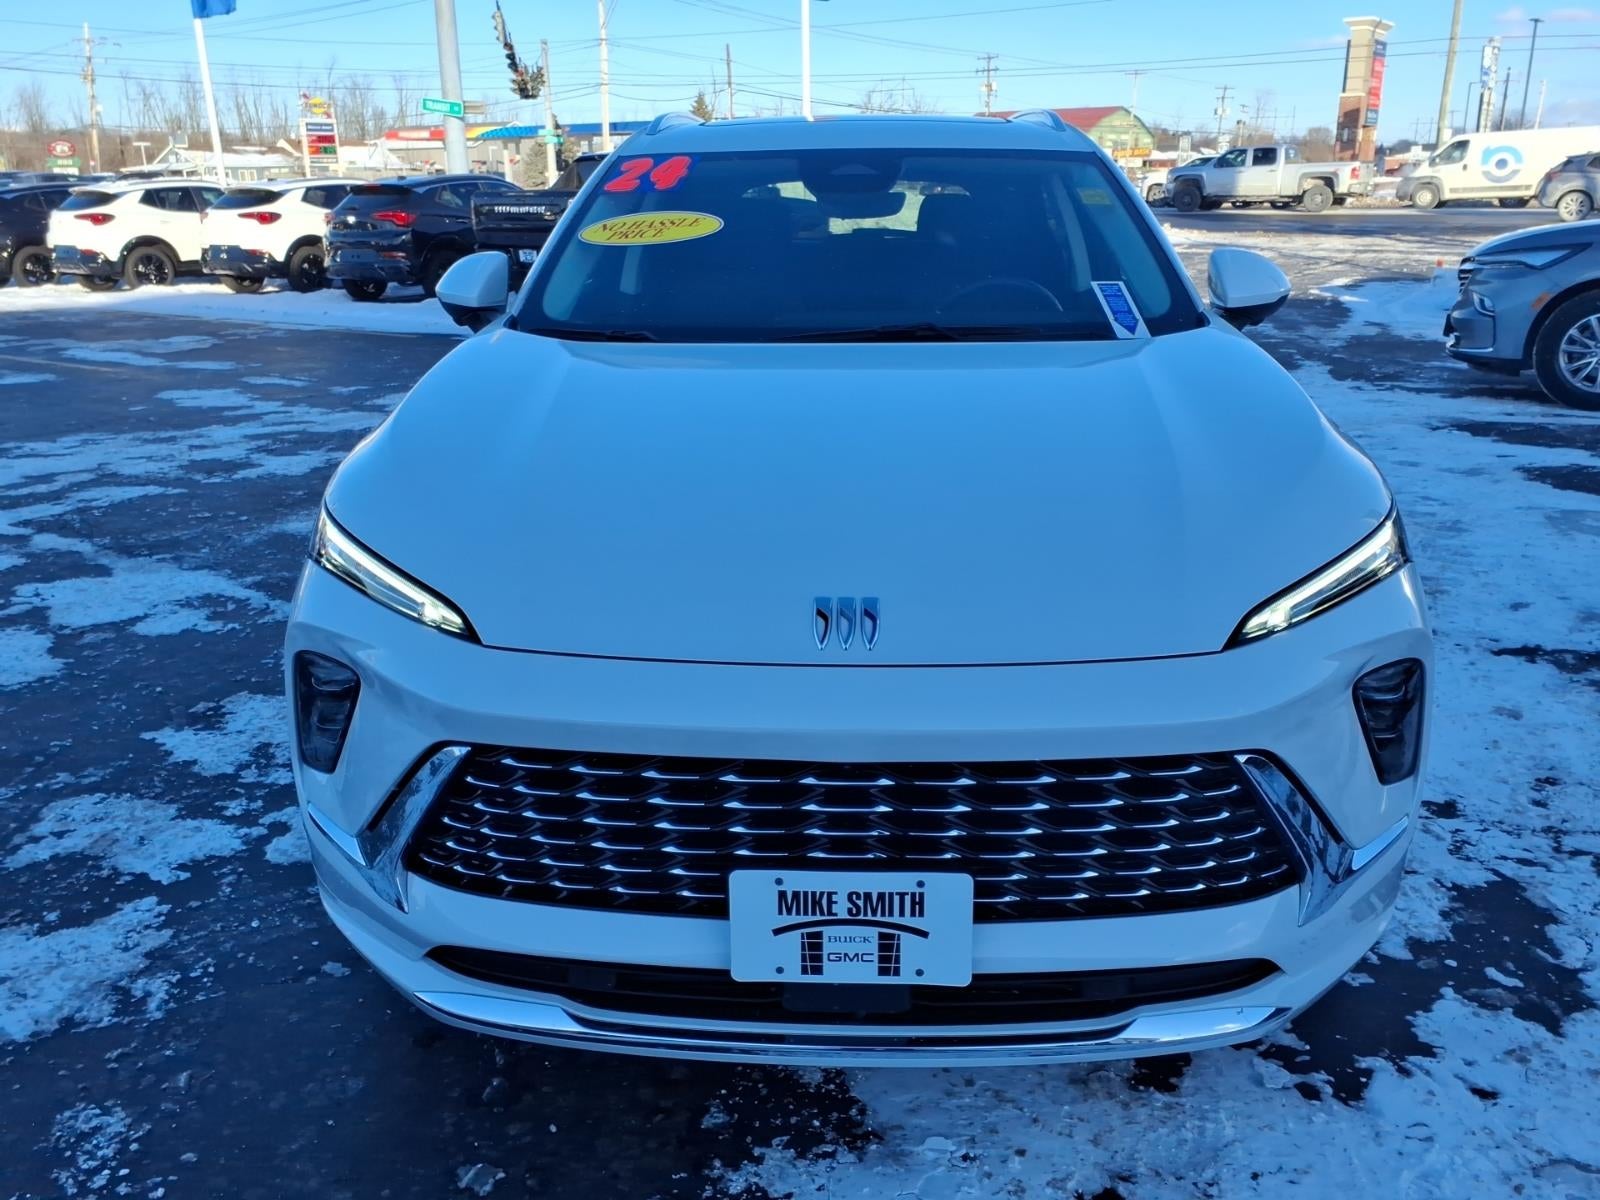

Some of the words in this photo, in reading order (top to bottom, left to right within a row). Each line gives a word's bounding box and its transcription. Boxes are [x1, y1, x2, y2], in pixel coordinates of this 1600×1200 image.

[604, 156, 692, 191] 24
[594, 222, 626, 232] NO
[627, 217, 706, 230] HASSLE
[606, 228, 667, 241] PRICE
[777, 889, 839, 917] MIKE
[846, 890, 925, 918] SMITH
[827, 935, 873, 944] BUICK
[826, 952, 875, 963] GMC
